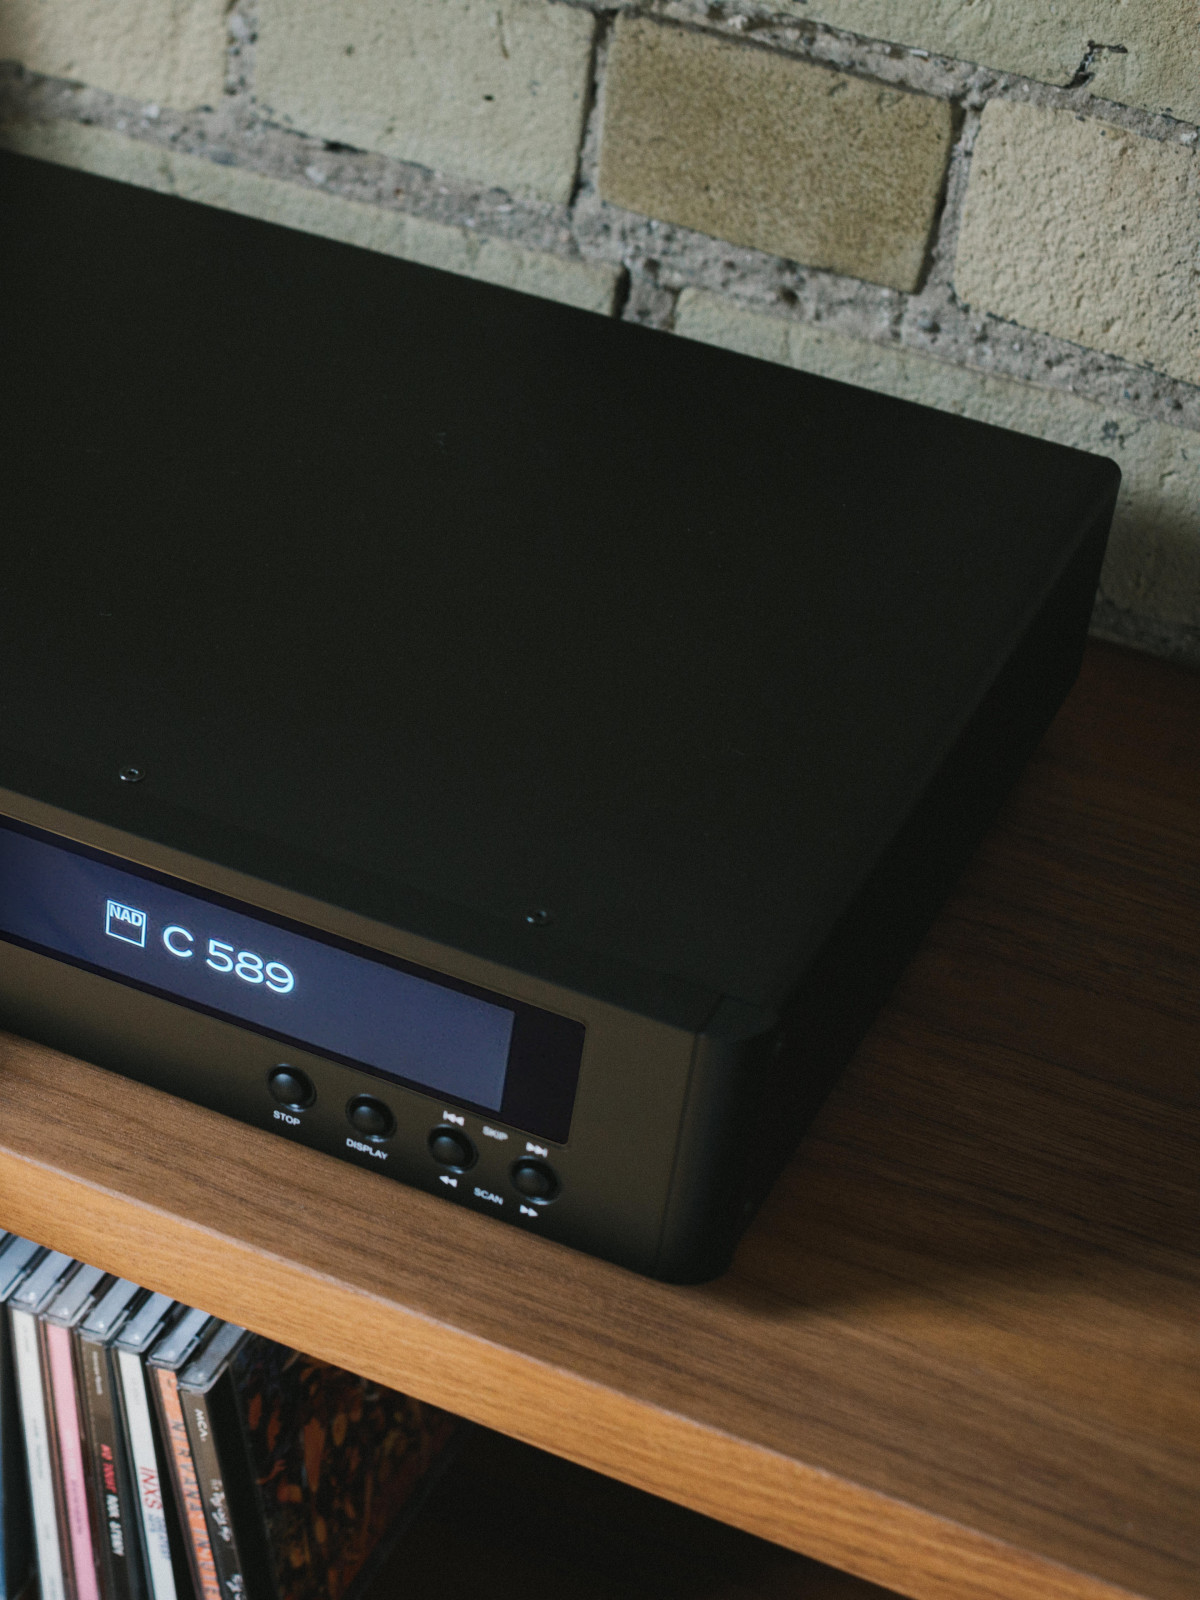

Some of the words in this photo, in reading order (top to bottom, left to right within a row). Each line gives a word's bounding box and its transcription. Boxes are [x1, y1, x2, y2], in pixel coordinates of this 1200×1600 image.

[109, 903, 144, 928] NAD
[162, 925, 195, 958] C
[206, 939, 296, 994] 589
[273, 1110, 301, 1126] STOP
[482, 1125, 509, 1141] SKIP
[346, 1138, 388, 1160] DISPLAY
[473, 1187, 504, 1205] SCAN
[194, 1408, 208, 1440] MCA
[171, 1420, 201, 1512] NIRVANA
[139, 1466, 163, 1509] INXS
